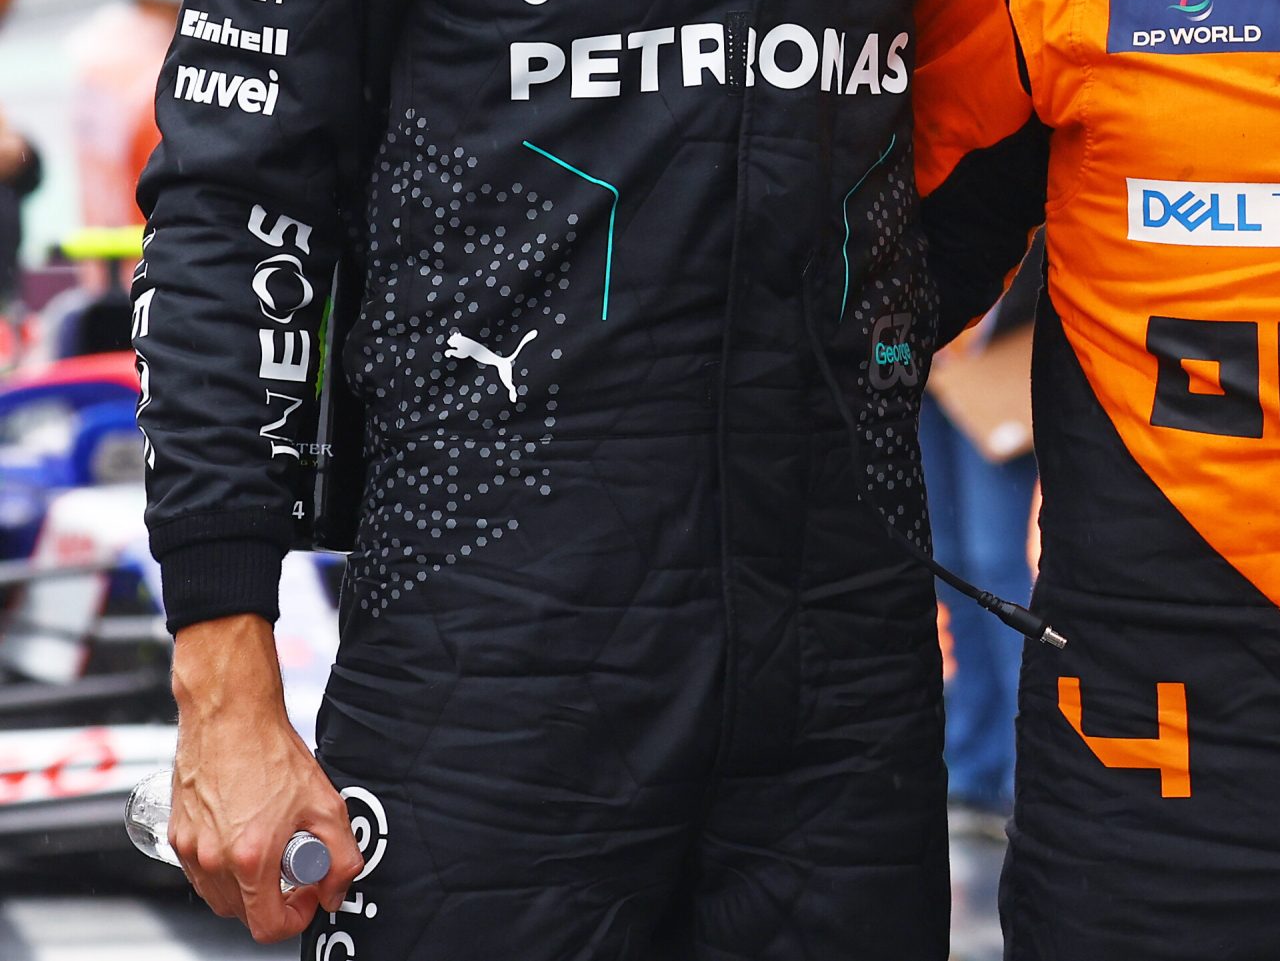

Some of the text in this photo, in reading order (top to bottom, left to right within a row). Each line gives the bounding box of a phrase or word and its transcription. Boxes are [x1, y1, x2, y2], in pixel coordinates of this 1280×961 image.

[180, 8, 289, 57] Einhell
[1132, 23, 1262, 48] DP WORLD
[509, 22, 909, 101] PETRONAS
[173, 64, 280, 116] nuvei
[1142, 188, 1263, 233] DELL
[247, 203, 315, 461] INEOS
[875, 342, 912, 366] George
[1057, 676, 1192, 798] 4
